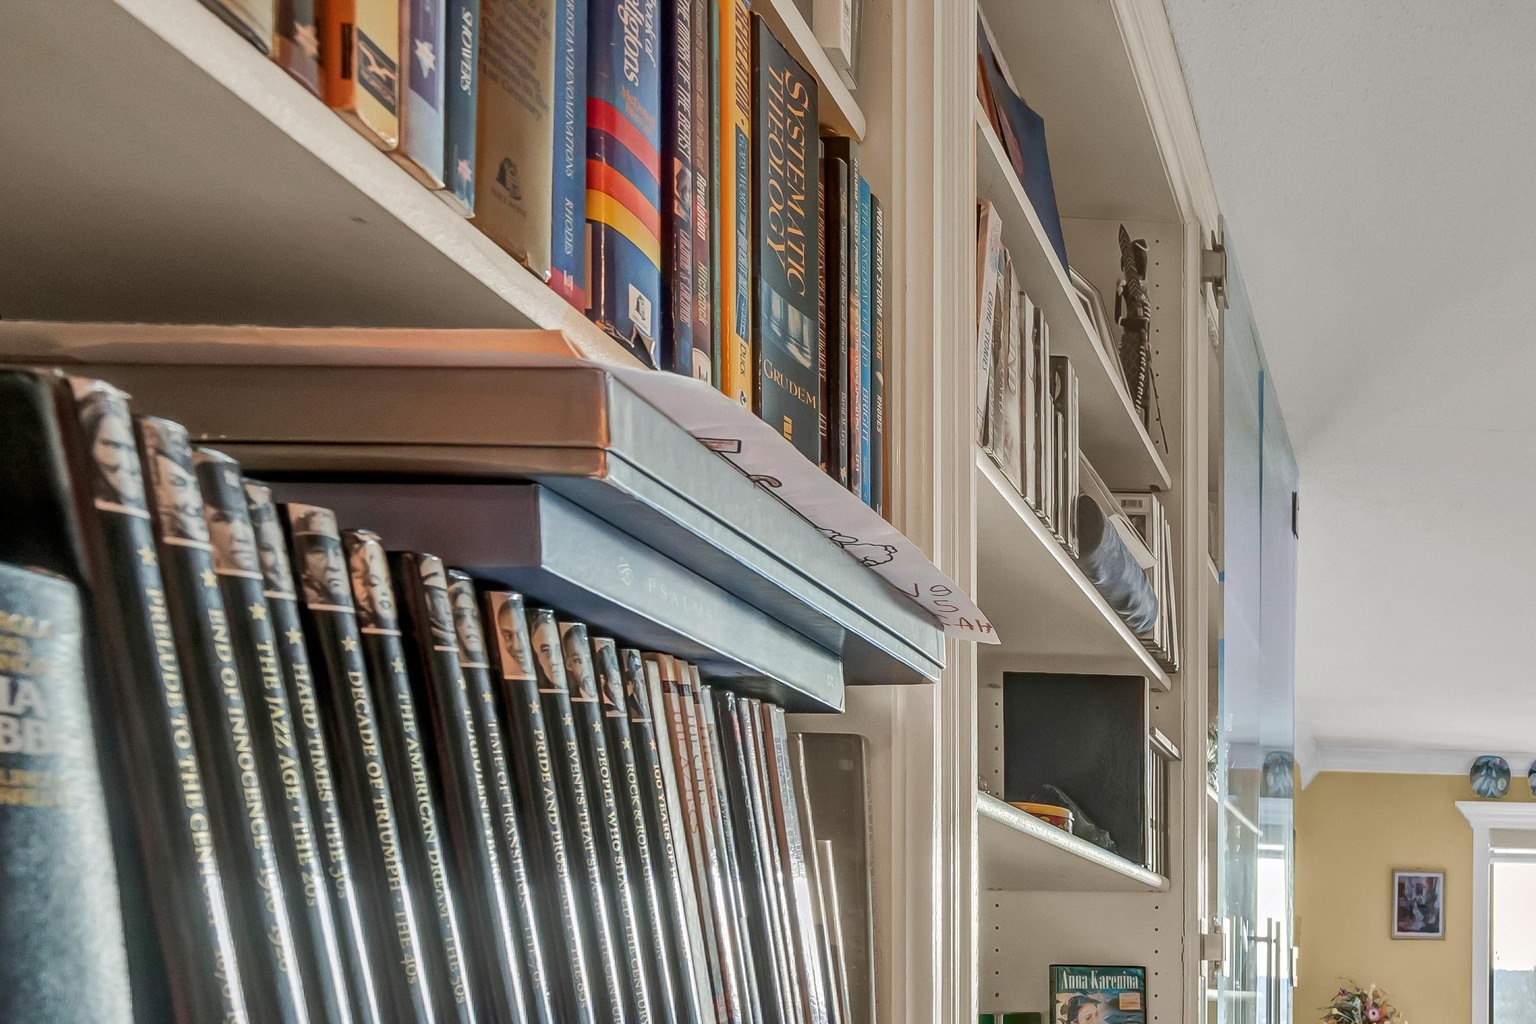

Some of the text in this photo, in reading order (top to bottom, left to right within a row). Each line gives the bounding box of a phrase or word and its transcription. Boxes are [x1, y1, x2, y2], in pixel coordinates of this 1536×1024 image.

[460, 10, 474, 94] SHOWERS
[678, 19, 691, 62] MARK
[735, 1, 748, 120] REVELATION
[565, 54, 575, 178] DENOMINATIONS
[677, 83, 691, 117] THE
[677, 110, 691, 162] BEAST
[767, 66, 786, 272] THEOLOGY
[785, 68, 809, 298] SYSTEMATIC
[564, 198, 575, 256] RHODES
[696, 172, 707, 241] Revelation
[861, 203, 869, 231] THE
[697, 261, 708, 327] Hitchcock
[861, 233, 870, 309] KINGDOM
[861, 310, 870, 328] OF
[981, 290, 993, 374] CRIME STORIES
[738, 343, 747, 377] DUCK
[763, 359, 816, 410] GRUDEM
[862, 387, 870, 446] BRIGHT
[145, 586, 183, 707] PRELUDE
[168, 714, 191, 749] TO
[207, 607, 269, 850] END OF INNOCENCE
[256, 639, 301, 800] THE JAZZ AGE
[291, 660, 333, 802] HARD TIMES
[176, 755, 201, 802] THE
[346, 669, 403, 892] DECADE OF TRIUMPH
[395, 690, 451, 919] THE AMERICAN DREAM
[532, 727, 560, 825] PRIDE AND
[564, 739, 585, 806] EVENTS
[576, 808, 593, 852] THAT
[594, 745, 615, 808] PEOPLE
[624, 762, 640, 805] ROCK
[650, 763, 663, 789] 100
[289, 817, 313, 865] THE
[321, 817, 343, 862] THE
[605, 811, 622, 852] WHO
[631, 808, 642, 821] &
[634, 824, 649, 862] ROLL
[655, 793, 672, 840] YEARS
[663, 843, 675, 862] OF
[612, 855, 632, 918] SHAPED
[390, 908, 419, 985] THE 40s
[622, 923, 638, 956] THE
[440, 935, 465, 1005] THE 50s
[1061, 970, 1139, 991] Anna Karenina
